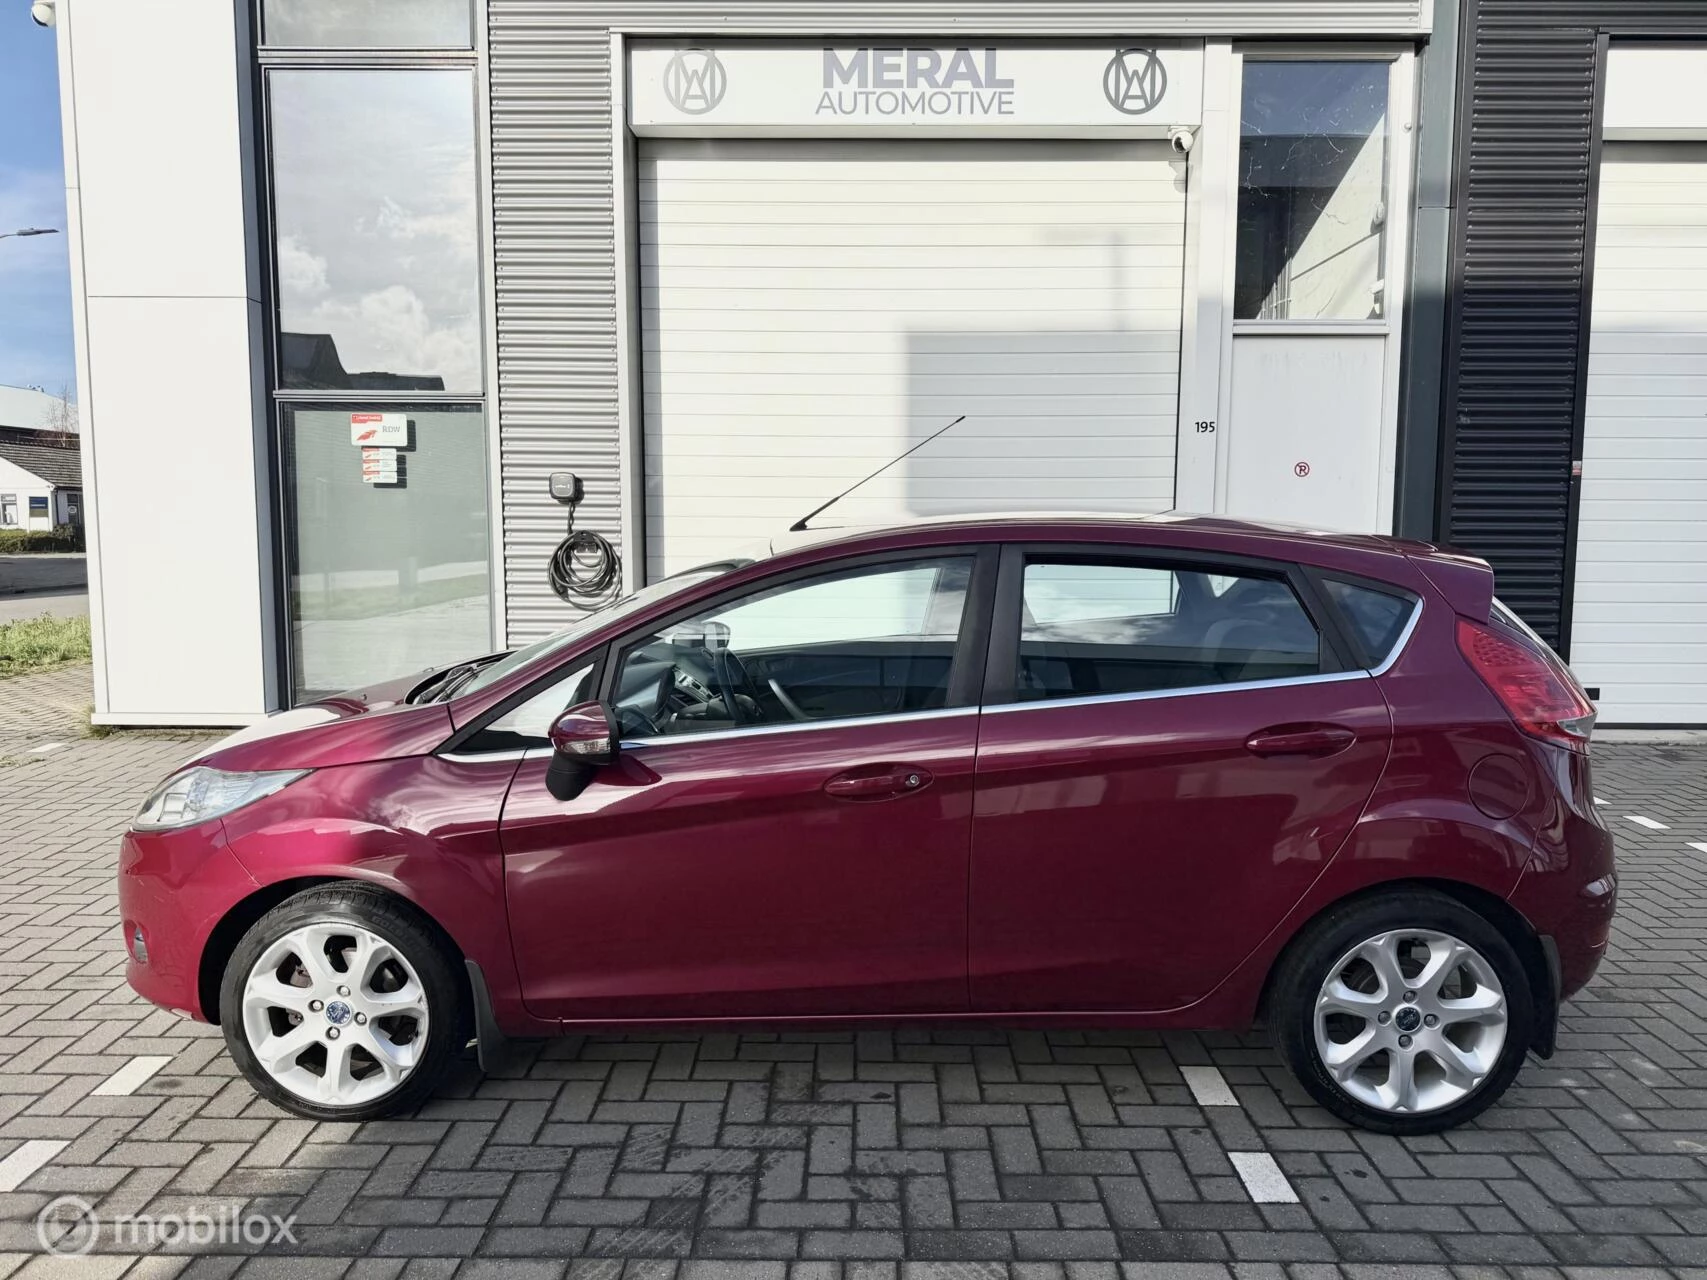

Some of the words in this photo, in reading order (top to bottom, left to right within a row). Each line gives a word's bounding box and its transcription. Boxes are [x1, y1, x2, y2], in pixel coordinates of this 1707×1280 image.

[823, 48, 1015, 89] MERAL
[815, 91, 1015, 115] AUTOMOTIVE
[382, 425, 401, 433] RDW
[1194, 421, 1216, 433] 195
